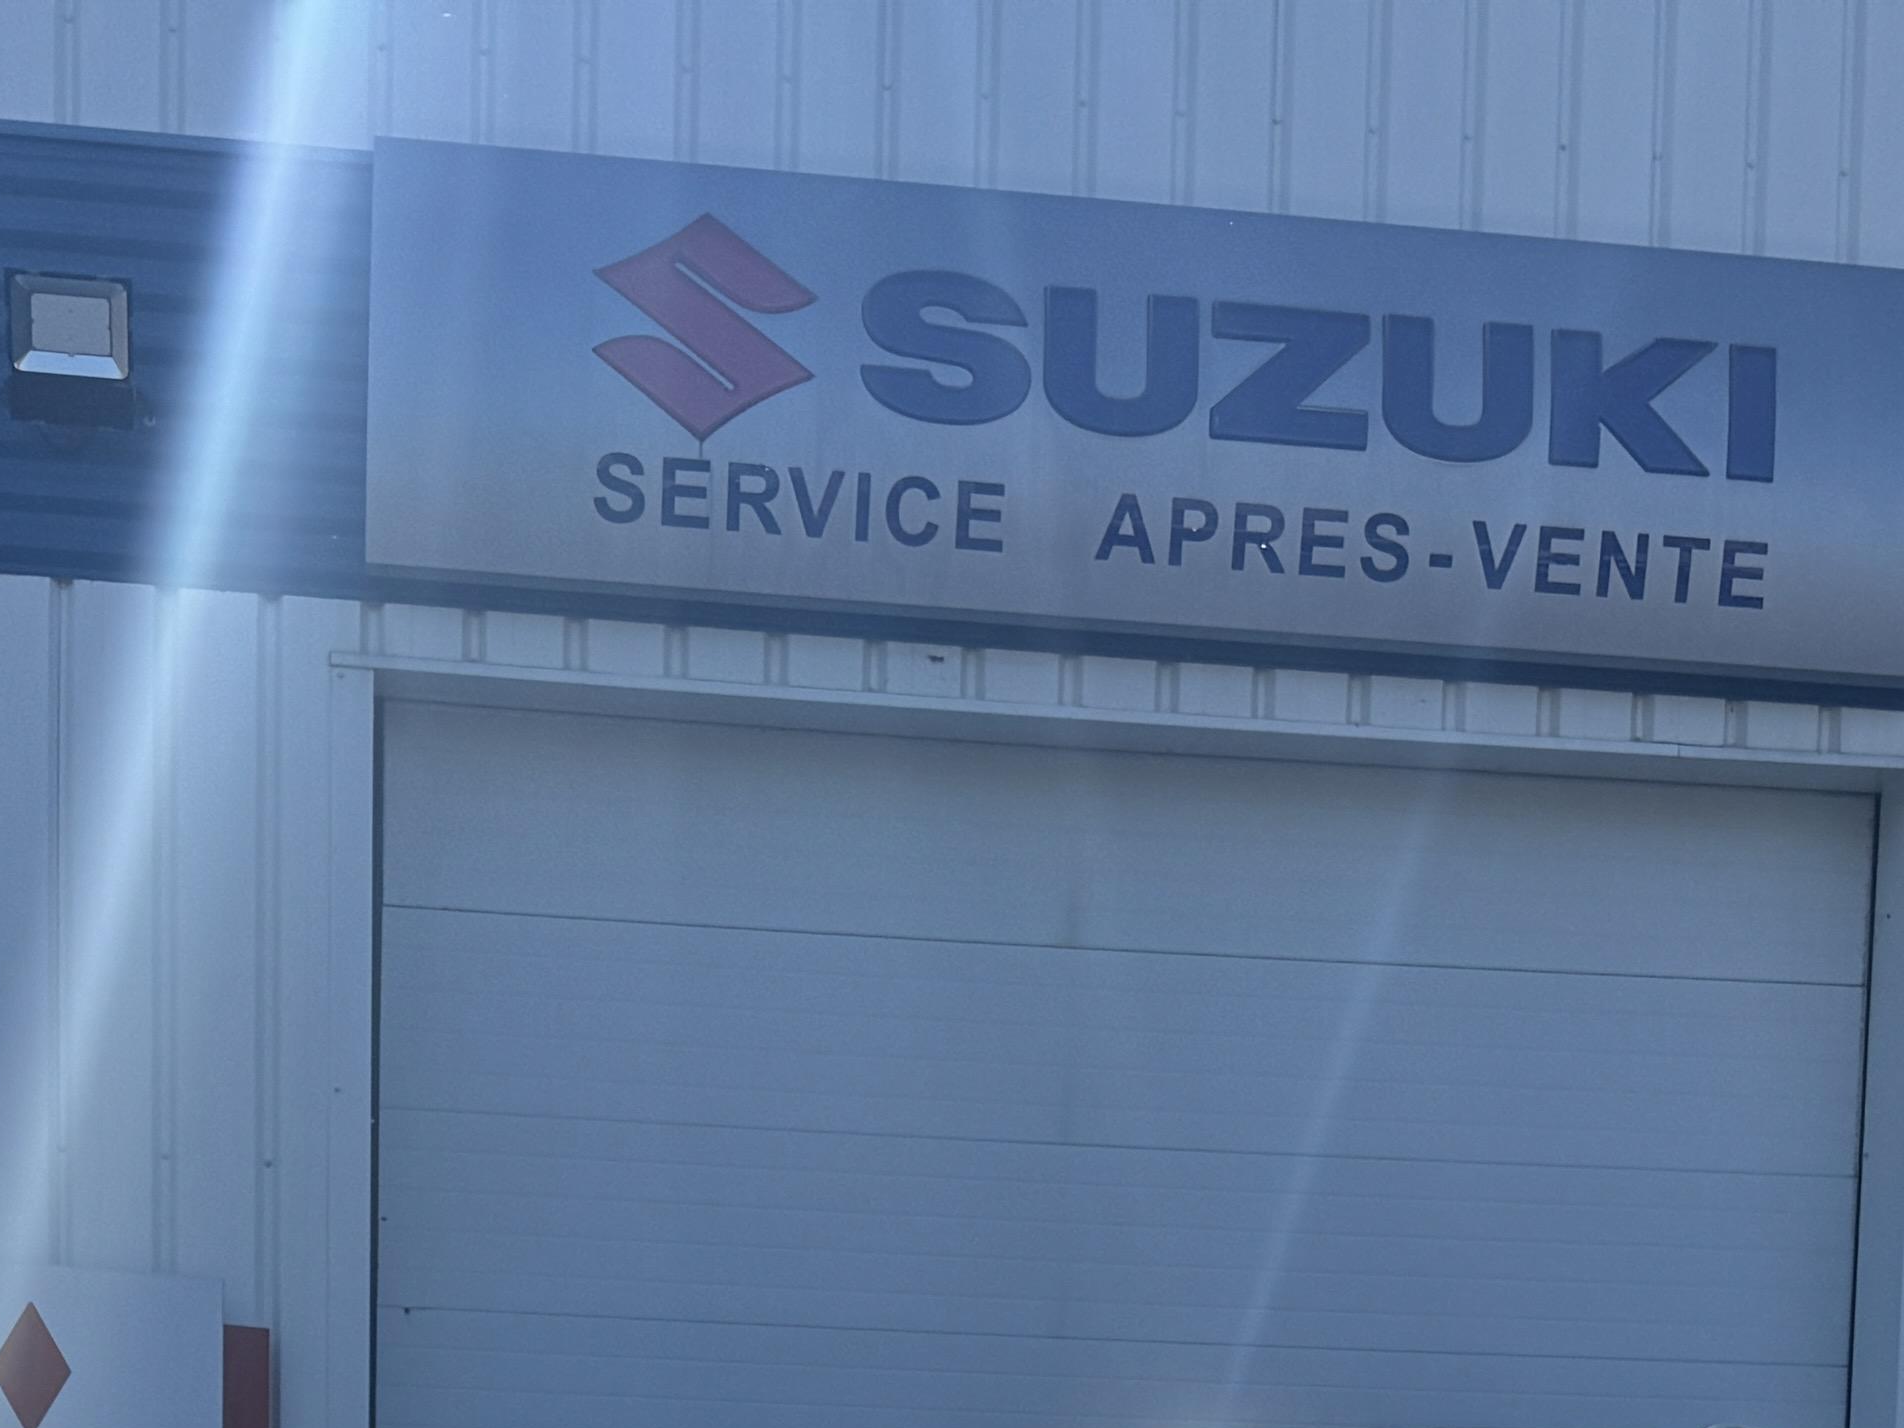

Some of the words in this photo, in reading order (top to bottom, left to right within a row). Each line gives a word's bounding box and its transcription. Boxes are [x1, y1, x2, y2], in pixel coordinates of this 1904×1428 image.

[861, 268, 1779, 484] SUZUKI
[592, 451, 1008, 554] SERVICE
[1095, 491, 1770, 611] APRES-VENTE
